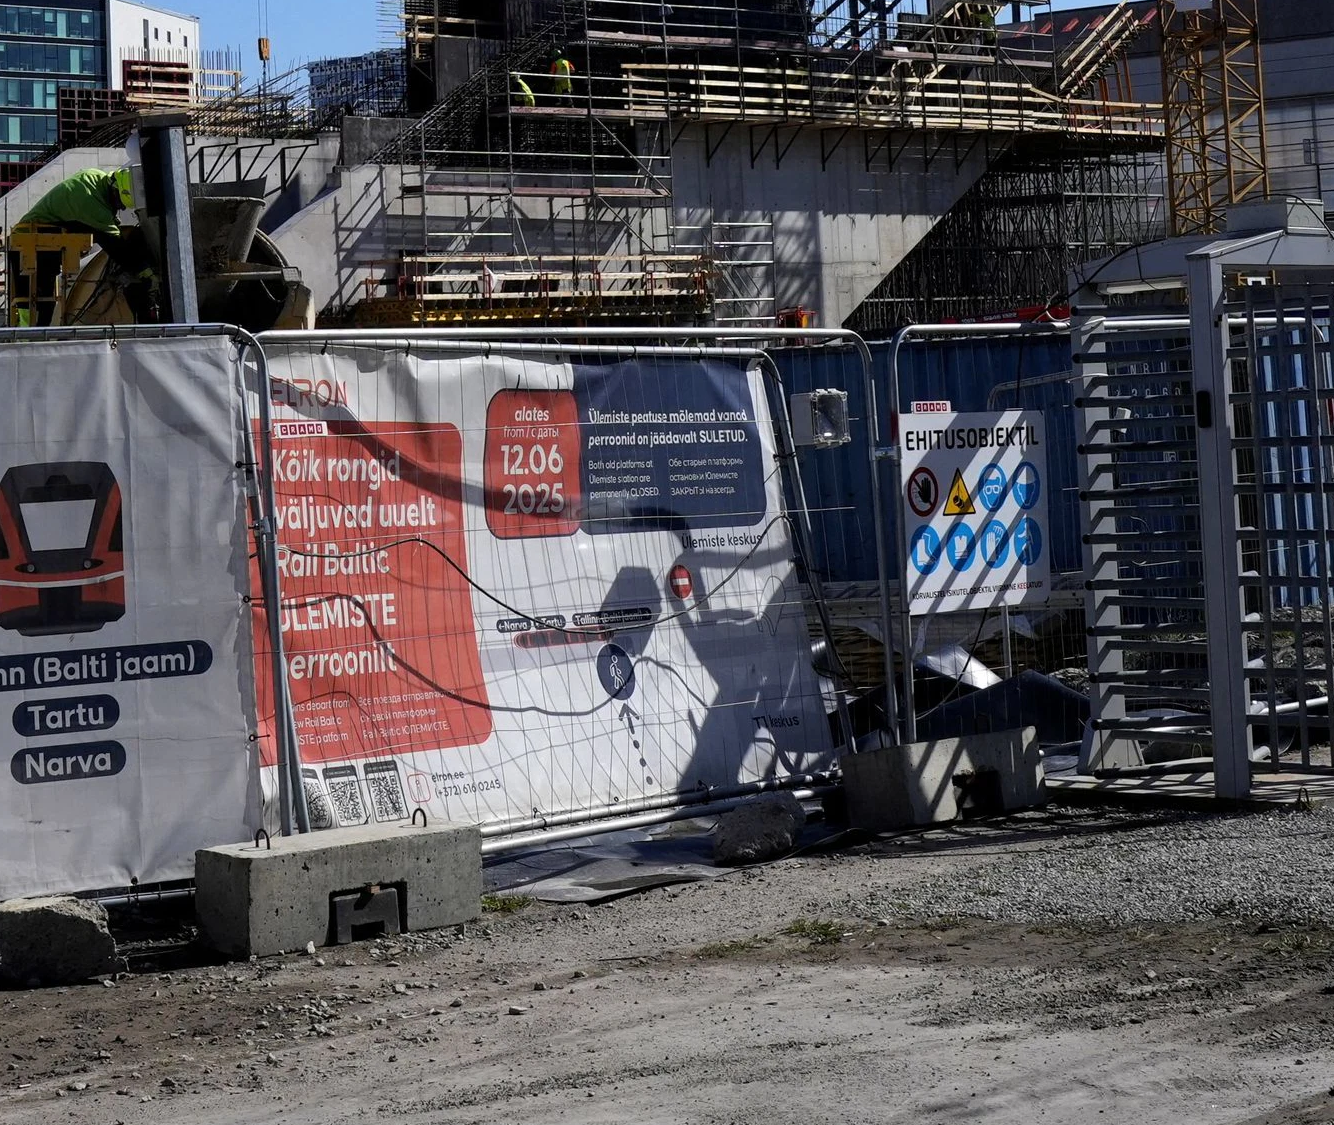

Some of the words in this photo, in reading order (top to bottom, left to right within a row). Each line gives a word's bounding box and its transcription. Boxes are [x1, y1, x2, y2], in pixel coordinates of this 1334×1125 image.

[270, 379, 347, 407] ELRON
[514, 406, 550, 422] alates
[588, 408, 630, 425] Ülemiste
[631, 412, 667, 426] peatuse
[669, 408, 715, 423] mõlemad
[718, 408, 747, 422] vanad
[280, 424, 323, 436] CRAMO
[503, 426, 524, 438] from
[588, 432, 636, 449] perroonid
[637, 435, 649, 445] on
[650, 430, 697, 448] jäädavalt
[699, 429, 748, 444] SULETUD.
[906, 425, 1039, 451] EHITUSOBJEKTIL
[272, 449, 320, 483] Kõik
[325, 449, 400, 489] rongid
[500, 444, 564, 475] 12.06
[588, 459, 604, 470] Both
[502, 483, 565, 515] 2025
[271, 491, 377, 540] väljuvad
[379, 493, 436, 529] uuelt
[681, 532, 725, 550] Ülemiste
[727, 532, 764, 548] keskus
[277, 546, 320, 580] Rail
[324, 541, 390, 577] Baltic
[280, 591, 397, 634] ÜLEMISTE
[503, 619, 528, 632] Narva
[32, 651, 109, 687] (Balti
[112, 643, 197, 683] jaam)
[285, 639, 398, 681] erroonilt
[27, 702, 106, 733] Tartu
[769, 714, 801, 728] keskus
[24, 749, 113, 781] Narva
[431, 770, 465, 782] elron.ee
